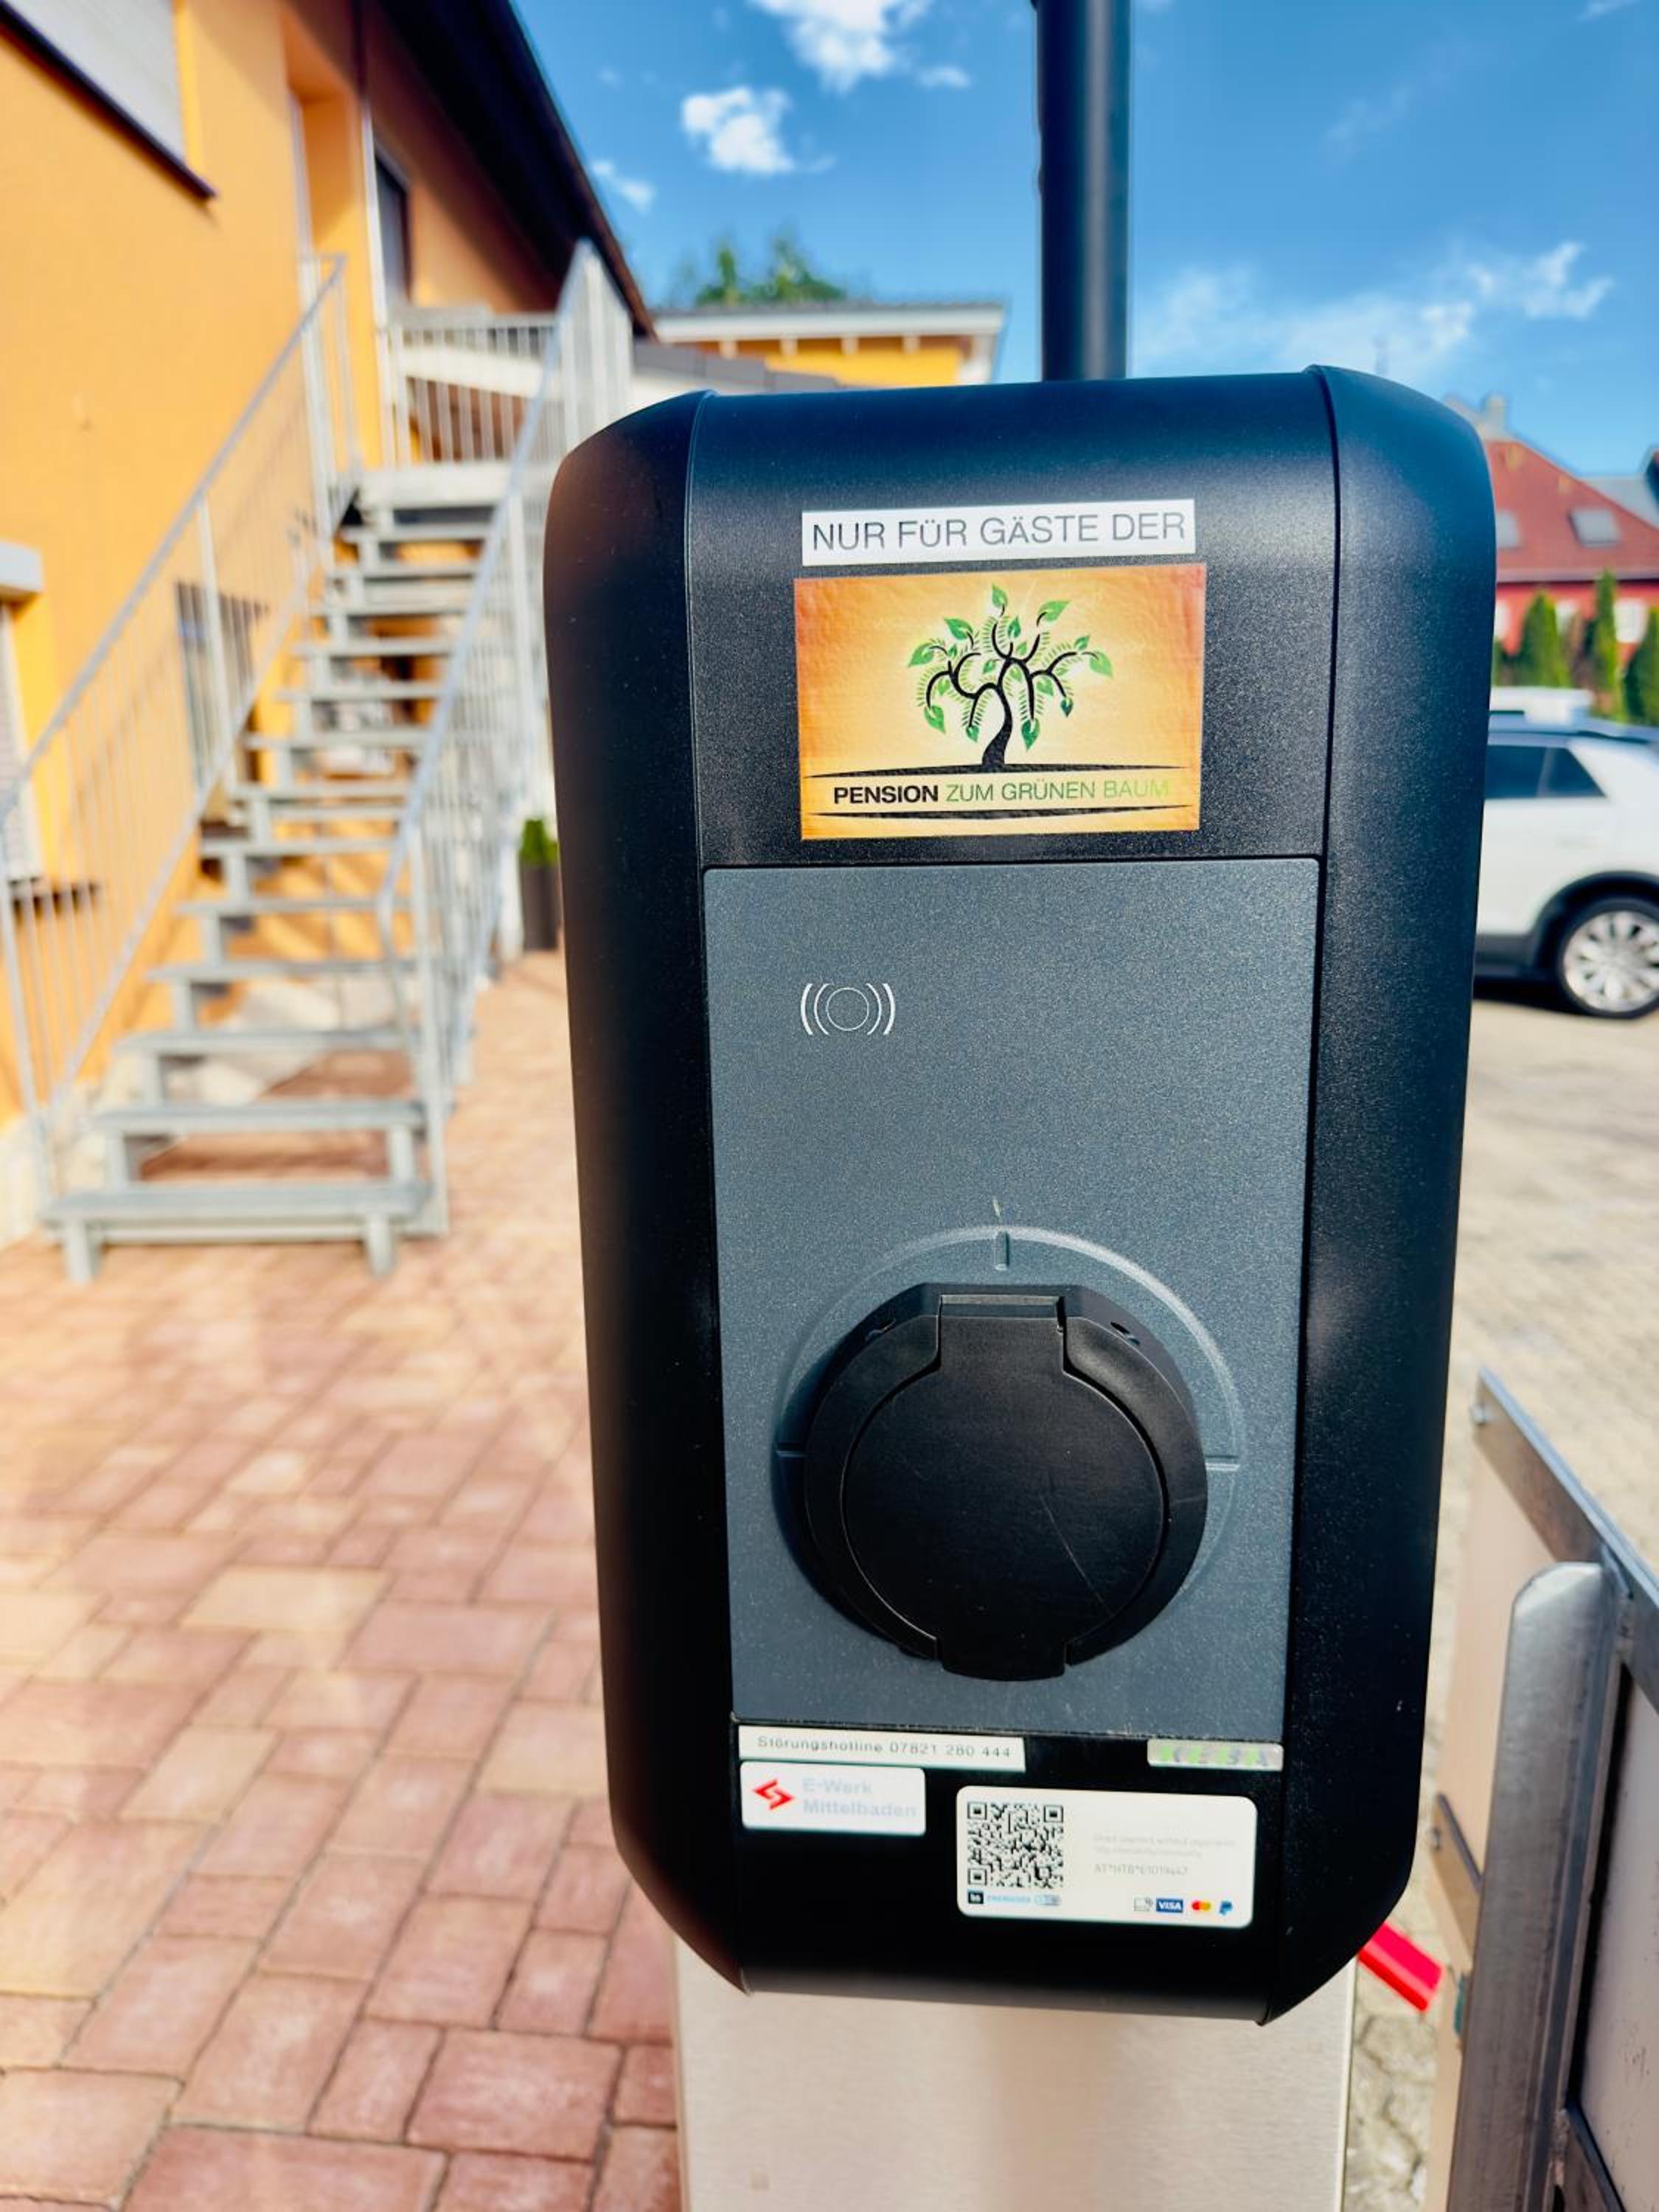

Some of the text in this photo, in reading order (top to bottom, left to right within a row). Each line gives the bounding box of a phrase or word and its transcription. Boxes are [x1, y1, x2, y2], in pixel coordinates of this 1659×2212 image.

[813, 512, 1185, 550] NUR FÜR GÄSTE DER
[833, 778, 1170, 804] PENSION ZUM GRÜNEN BAUM
[757, 1735, 883, 1753] Störungshotline
[982, 1747, 1010, 1758] 444
[802, 1777, 873, 1794] E-Werk
[803, 1798, 917, 1818] Mittelbaden
[1158, 1901, 1182, 1910] VISA
